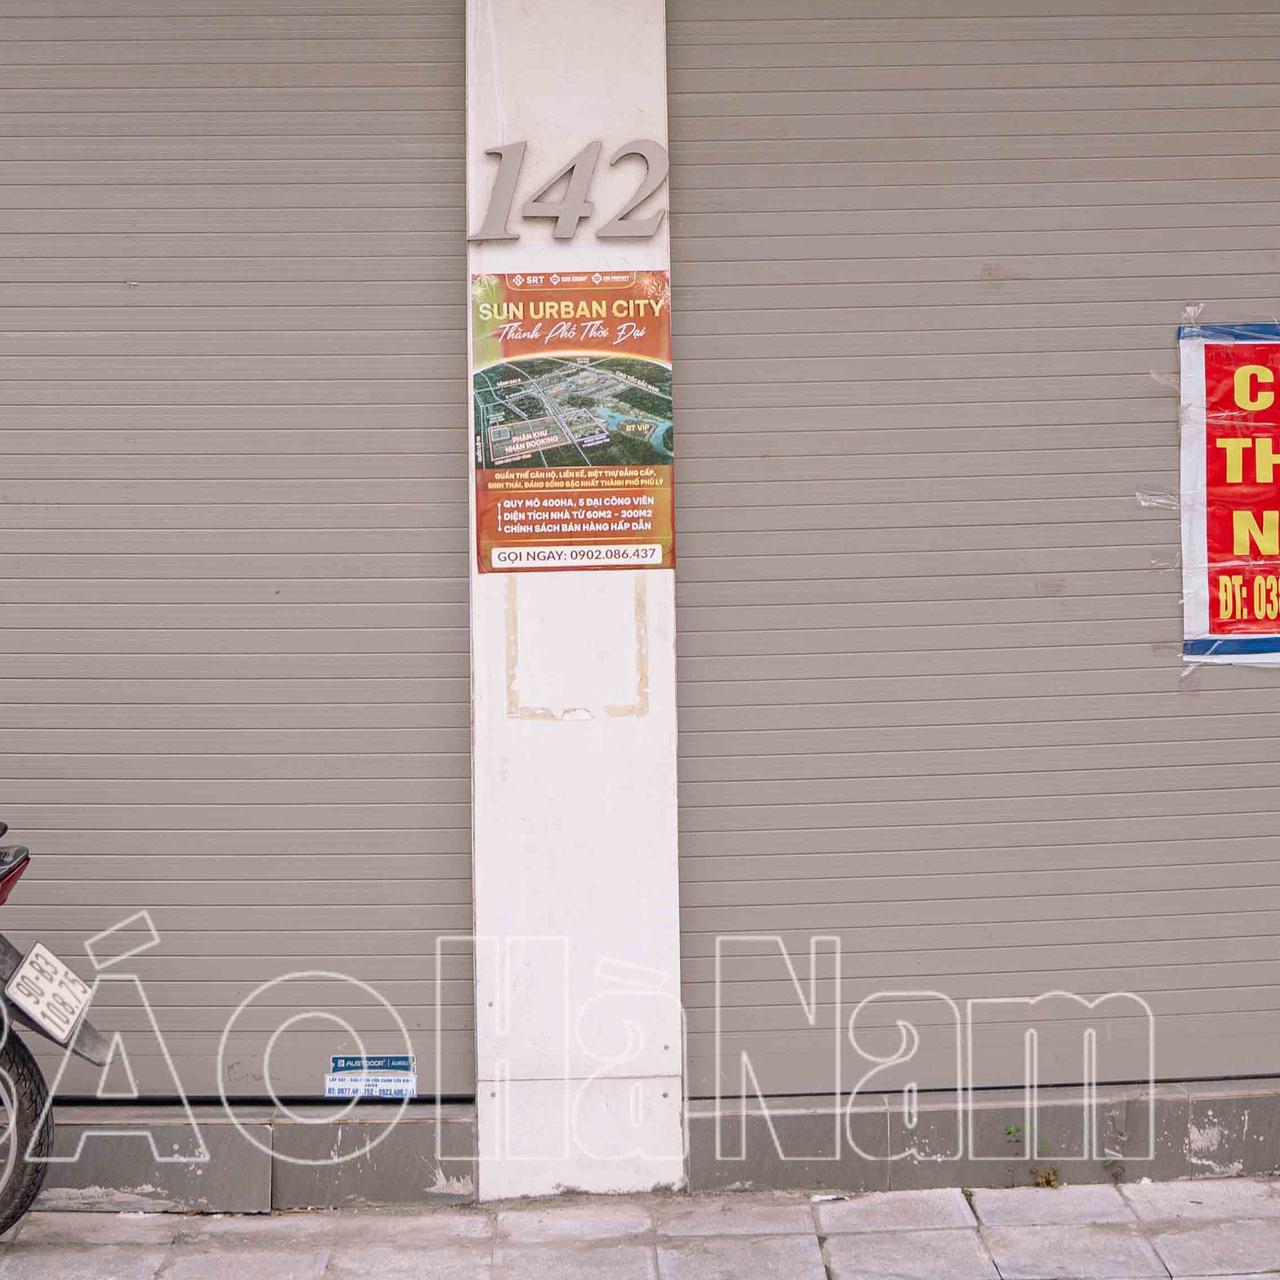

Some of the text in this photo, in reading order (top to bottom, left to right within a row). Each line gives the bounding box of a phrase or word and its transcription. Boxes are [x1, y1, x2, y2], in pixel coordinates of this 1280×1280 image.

[468, 138, 669, 241] 142
[526, 276, 544, 284] SRT
[479, 299, 665, 320] SUN URBAN CITY
[498, 320, 647, 345] Thành Phố Thời Đại
[504, 495, 654, 508] QUY MÔ 400HA, 5 ĐẠI CÔNG VIÊN
[504, 511, 526, 522] DIỆN
[527, 509, 550, 520] TÍCH
[550, 508, 570, 520] NHÀ
[572, 509, 586, 519] TỪ
[587, 510, 612, 518] 60M2
[620, 509, 653, 518] 300M2
[504, 518, 652, 533] CHÍNH SÁCH BÁN HÀNG HẤP DẪN
[498, 548, 656, 564] GỌI NGAY: 0902.086.437
[1219, 574, 1248, 619] ĐT:
[40, 970, 87, 1033] 108.75
